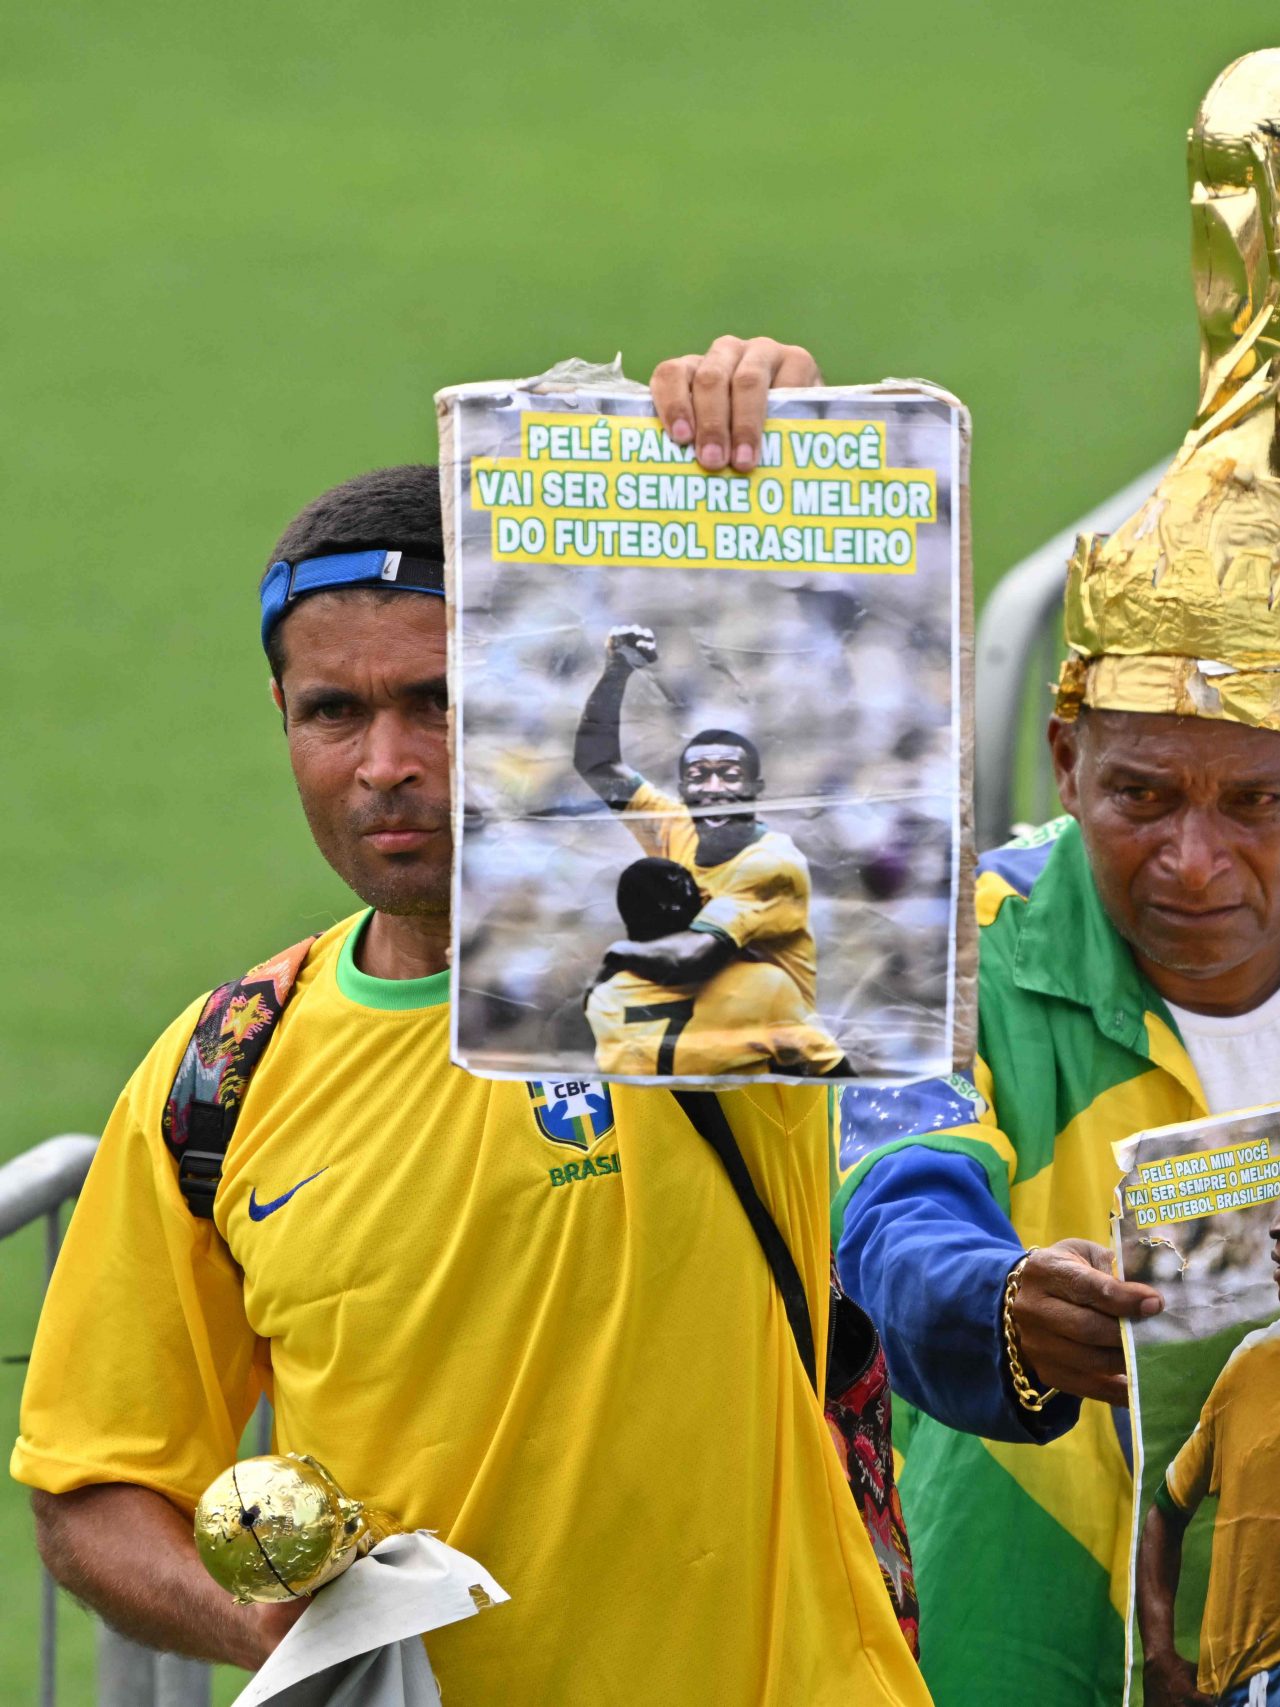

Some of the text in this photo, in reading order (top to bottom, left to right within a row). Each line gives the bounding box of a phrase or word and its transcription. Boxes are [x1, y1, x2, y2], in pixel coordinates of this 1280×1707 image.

[527, 420, 611, 461] PELÉ
[620, 427, 697, 463] PAR
[791, 426, 880, 468] VOCÊ
[476, 471, 931, 518] VAI SER SEMPRE O MELHOR
[498, 517, 912, 565] DO FUTEBOL BRASILEIRO
[624, 998, 695, 1075] 7
[554, 1081, 590, 1099] CBF
[549, 1152, 621, 1187] BRASI
[1142, 1142, 1269, 1183] PELÉ PARA MIM VOCÊ
[1127, 1189, 1148, 1207] VAI
[1152, 1184, 1176, 1202] SER
[1179, 1176, 1226, 1197] SEMPRE
[1229, 1172, 1238, 1186] O
[1137, 1181, 1280, 1225] DO FUTEBOL BRASILEIRO
